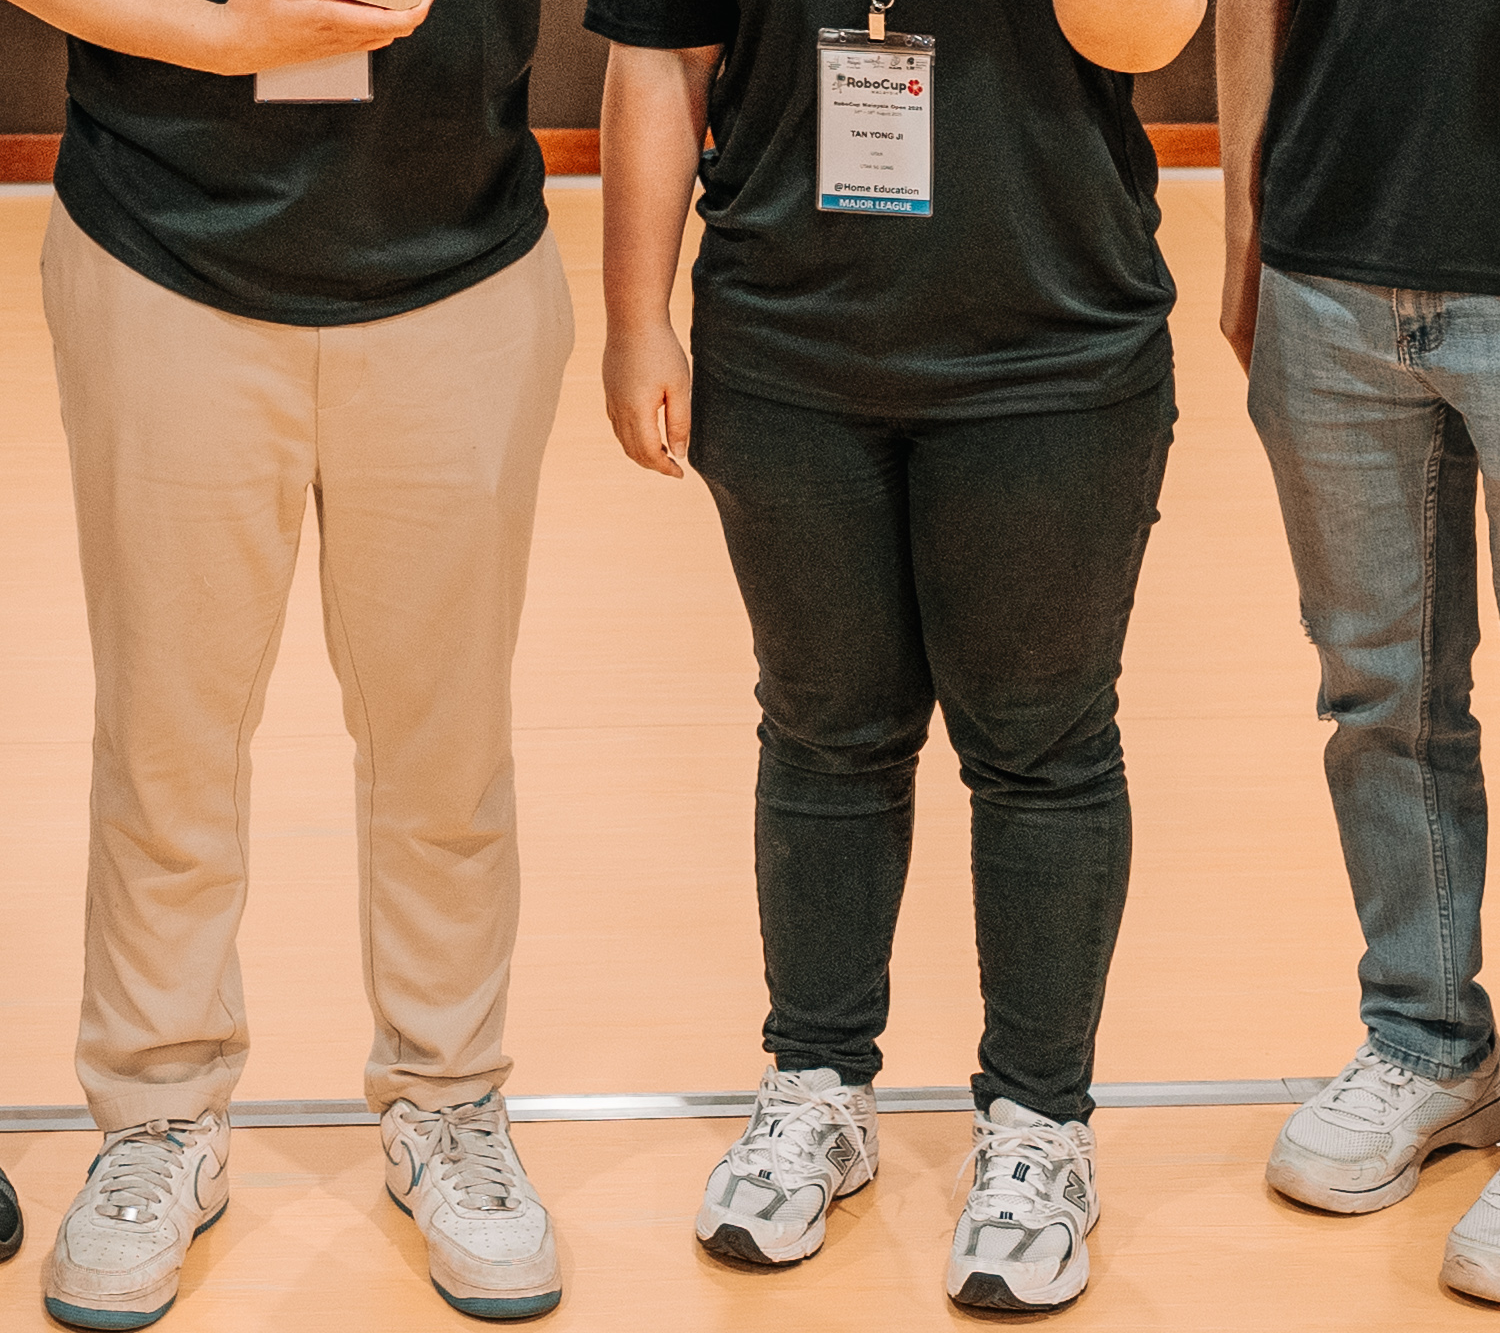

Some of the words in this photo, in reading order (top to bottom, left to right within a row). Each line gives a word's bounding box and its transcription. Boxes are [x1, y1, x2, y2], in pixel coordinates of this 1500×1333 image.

[847, 76, 906, 93] RoboCup
[850, 130, 867, 138] TAN
[869, 132, 894, 140] YONG
[834, 183, 871, 192] @Home
[874, 185, 919, 195] Education
[839, 199, 873, 209] MAJOR
[875, 201, 912, 211] LEAGUE
